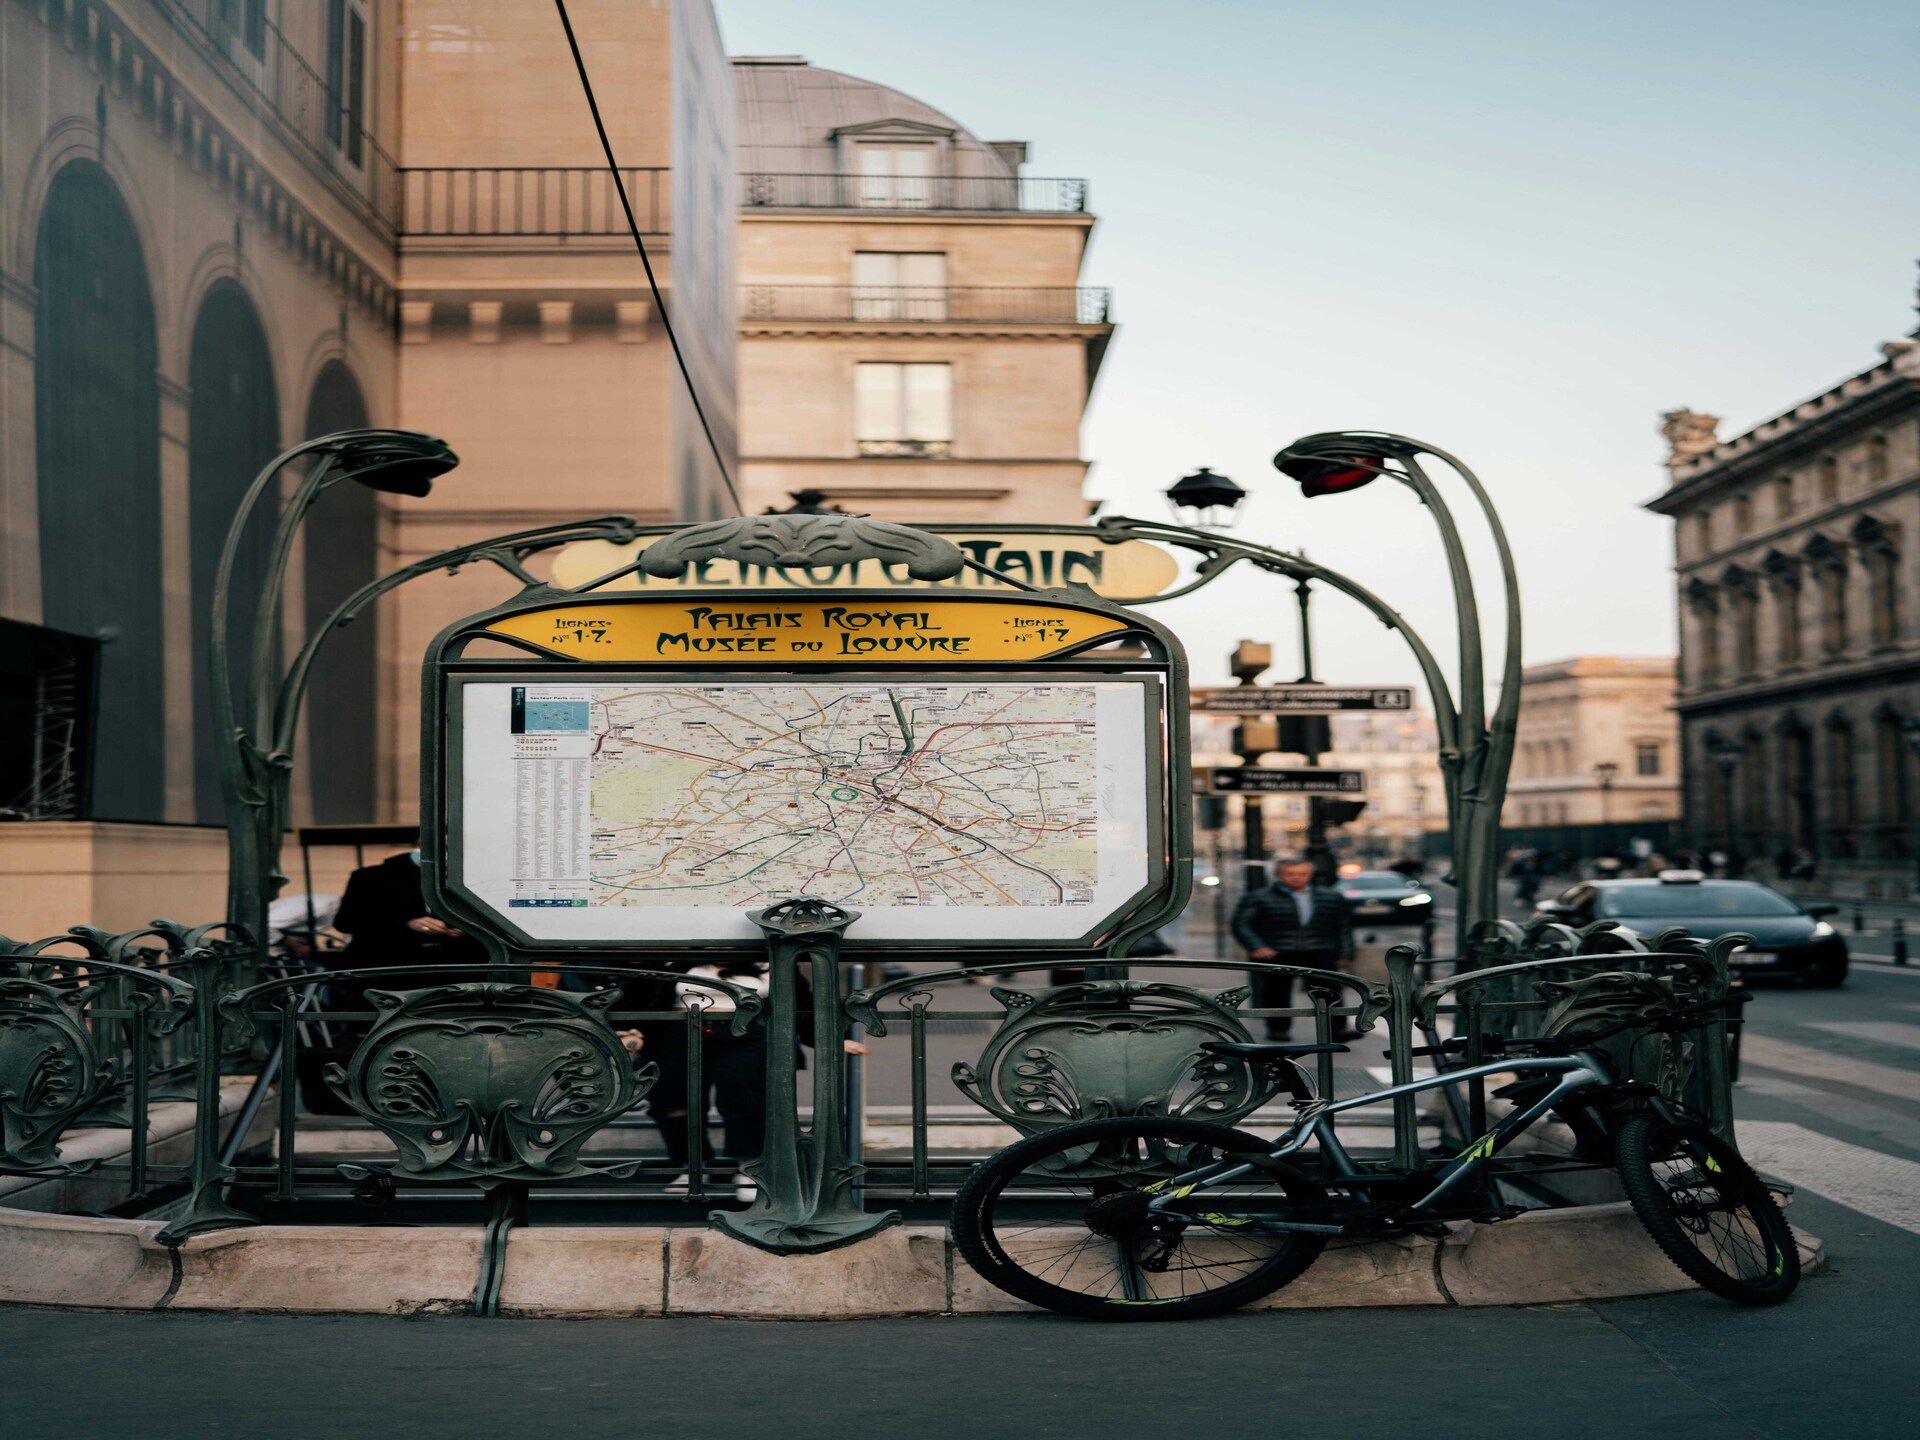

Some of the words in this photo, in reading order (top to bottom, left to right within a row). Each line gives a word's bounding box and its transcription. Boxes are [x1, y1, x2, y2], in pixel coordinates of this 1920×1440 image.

[555, 618, 605, 629] LIGNES
[685, 606, 803, 631] PALAIS
[821, 607, 942, 631] ROYAL
[1014, 617, 1064, 628] LIGNES
[656, 632, 777, 655] MUSÉE
[791, 640, 823, 652] DU
[837, 632, 971, 655] LOUVRE
